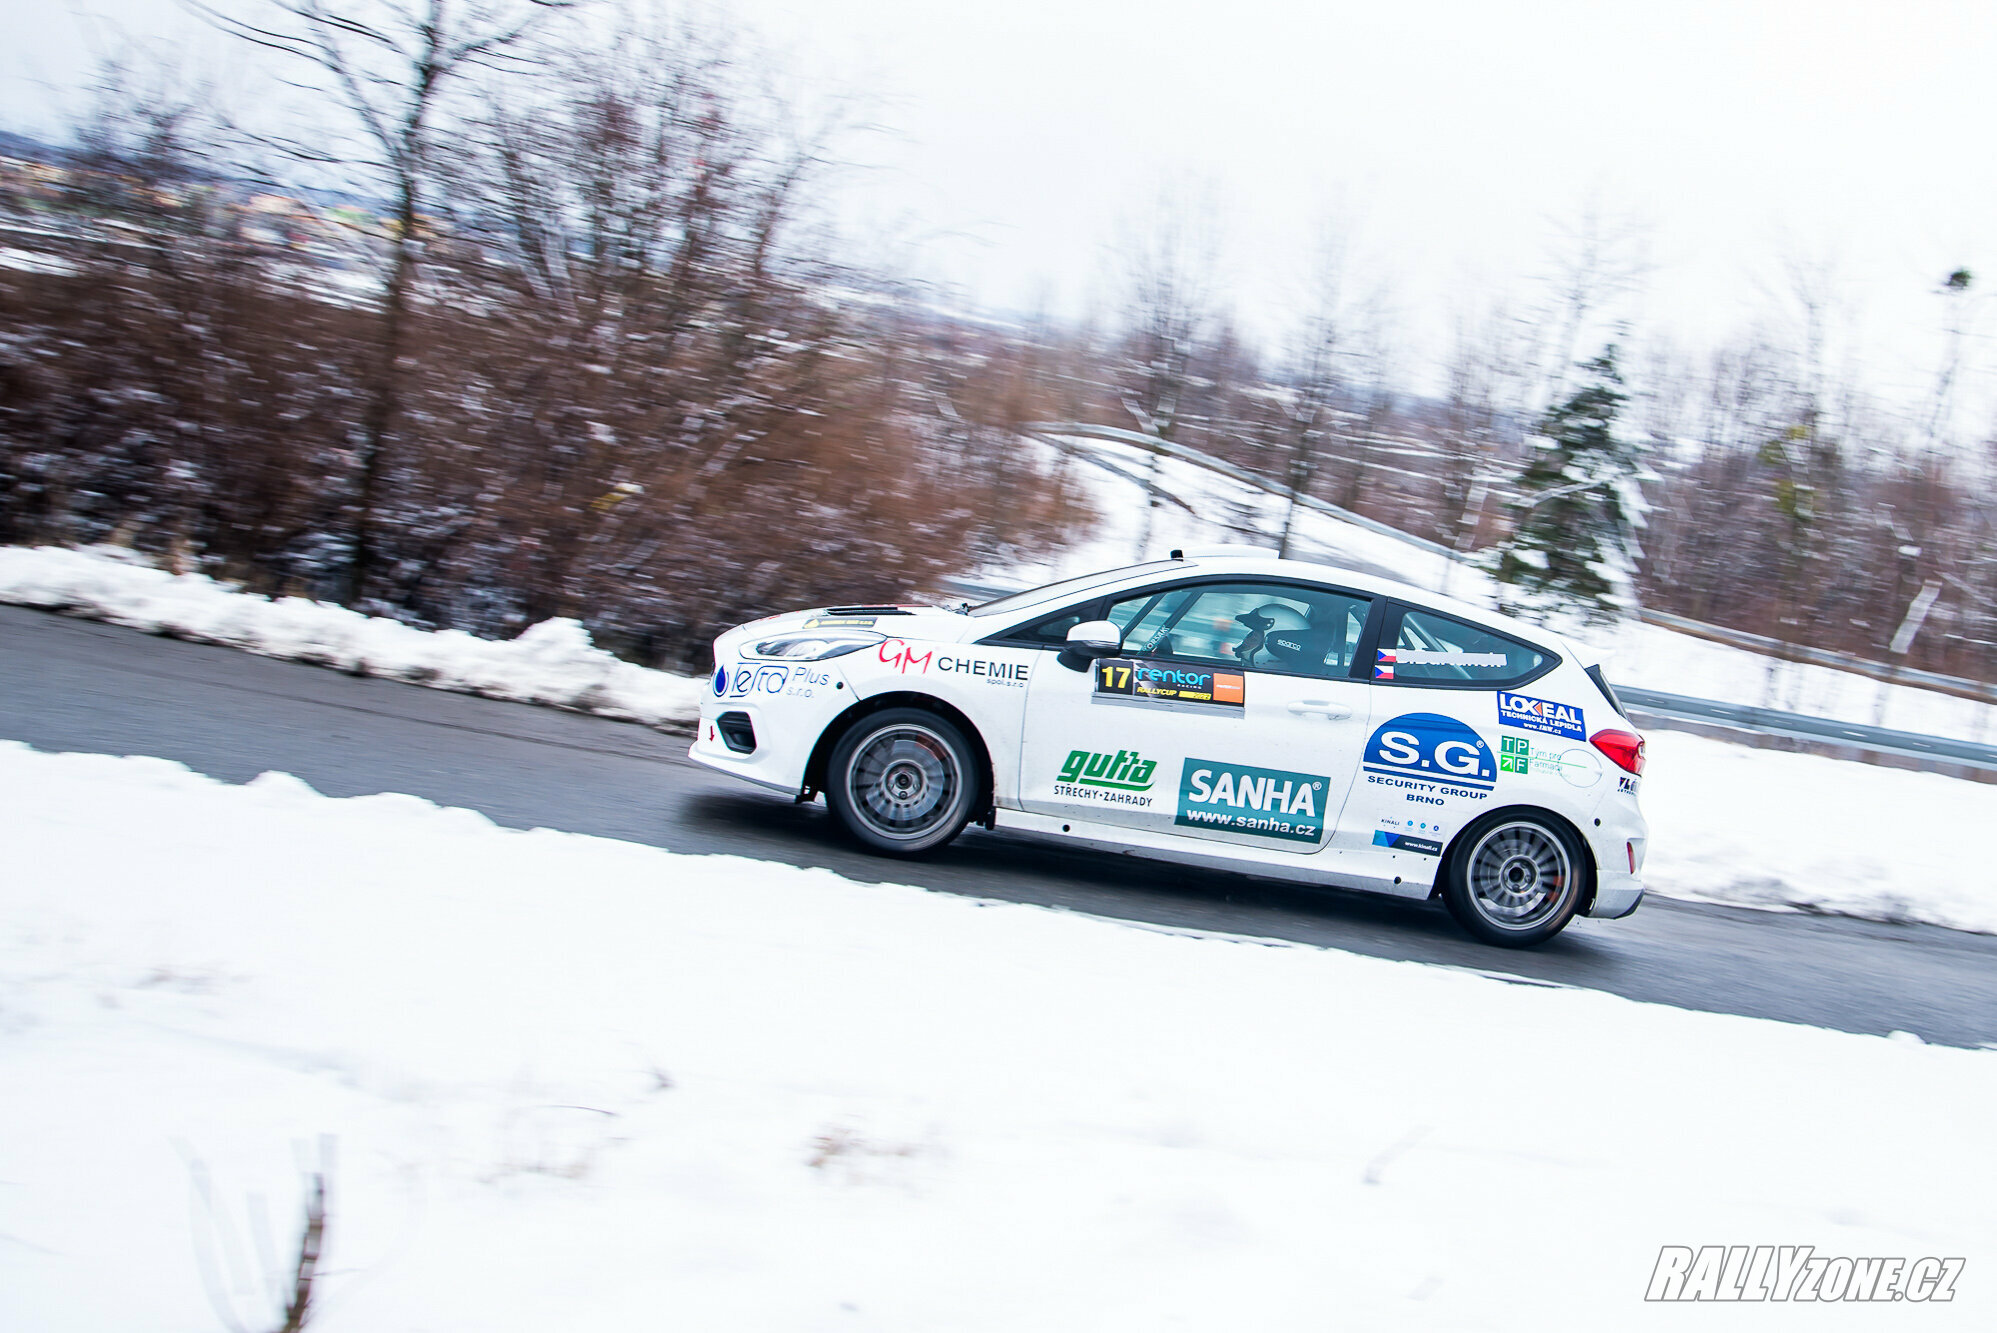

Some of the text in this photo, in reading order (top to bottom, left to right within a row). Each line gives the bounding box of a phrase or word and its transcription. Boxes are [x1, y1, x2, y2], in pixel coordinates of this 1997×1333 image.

[1277, 639, 1301, 651] sparco
[792, 667, 830, 686] Plus
[938, 657, 1028, 680] CHEMIE
[1101, 666, 1131, 688] 17
[1138, 667, 1211, 686] rentor
[1137, 686, 1177, 696] RALLYCUP
[1500, 694, 1582, 725] LOXEAL
[1550, 719, 1582, 732] LEPIDLA
[1379, 731, 1490, 777] S.G.
[1057, 750, 1157, 783] gutta
[1188, 769, 1315, 817] SANHA
[1368, 776, 1488, 800] SECURITY GROUP
[1406, 793, 1445, 806] BRNO
[1186, 809, 1315, 837] www.sanha.cz
